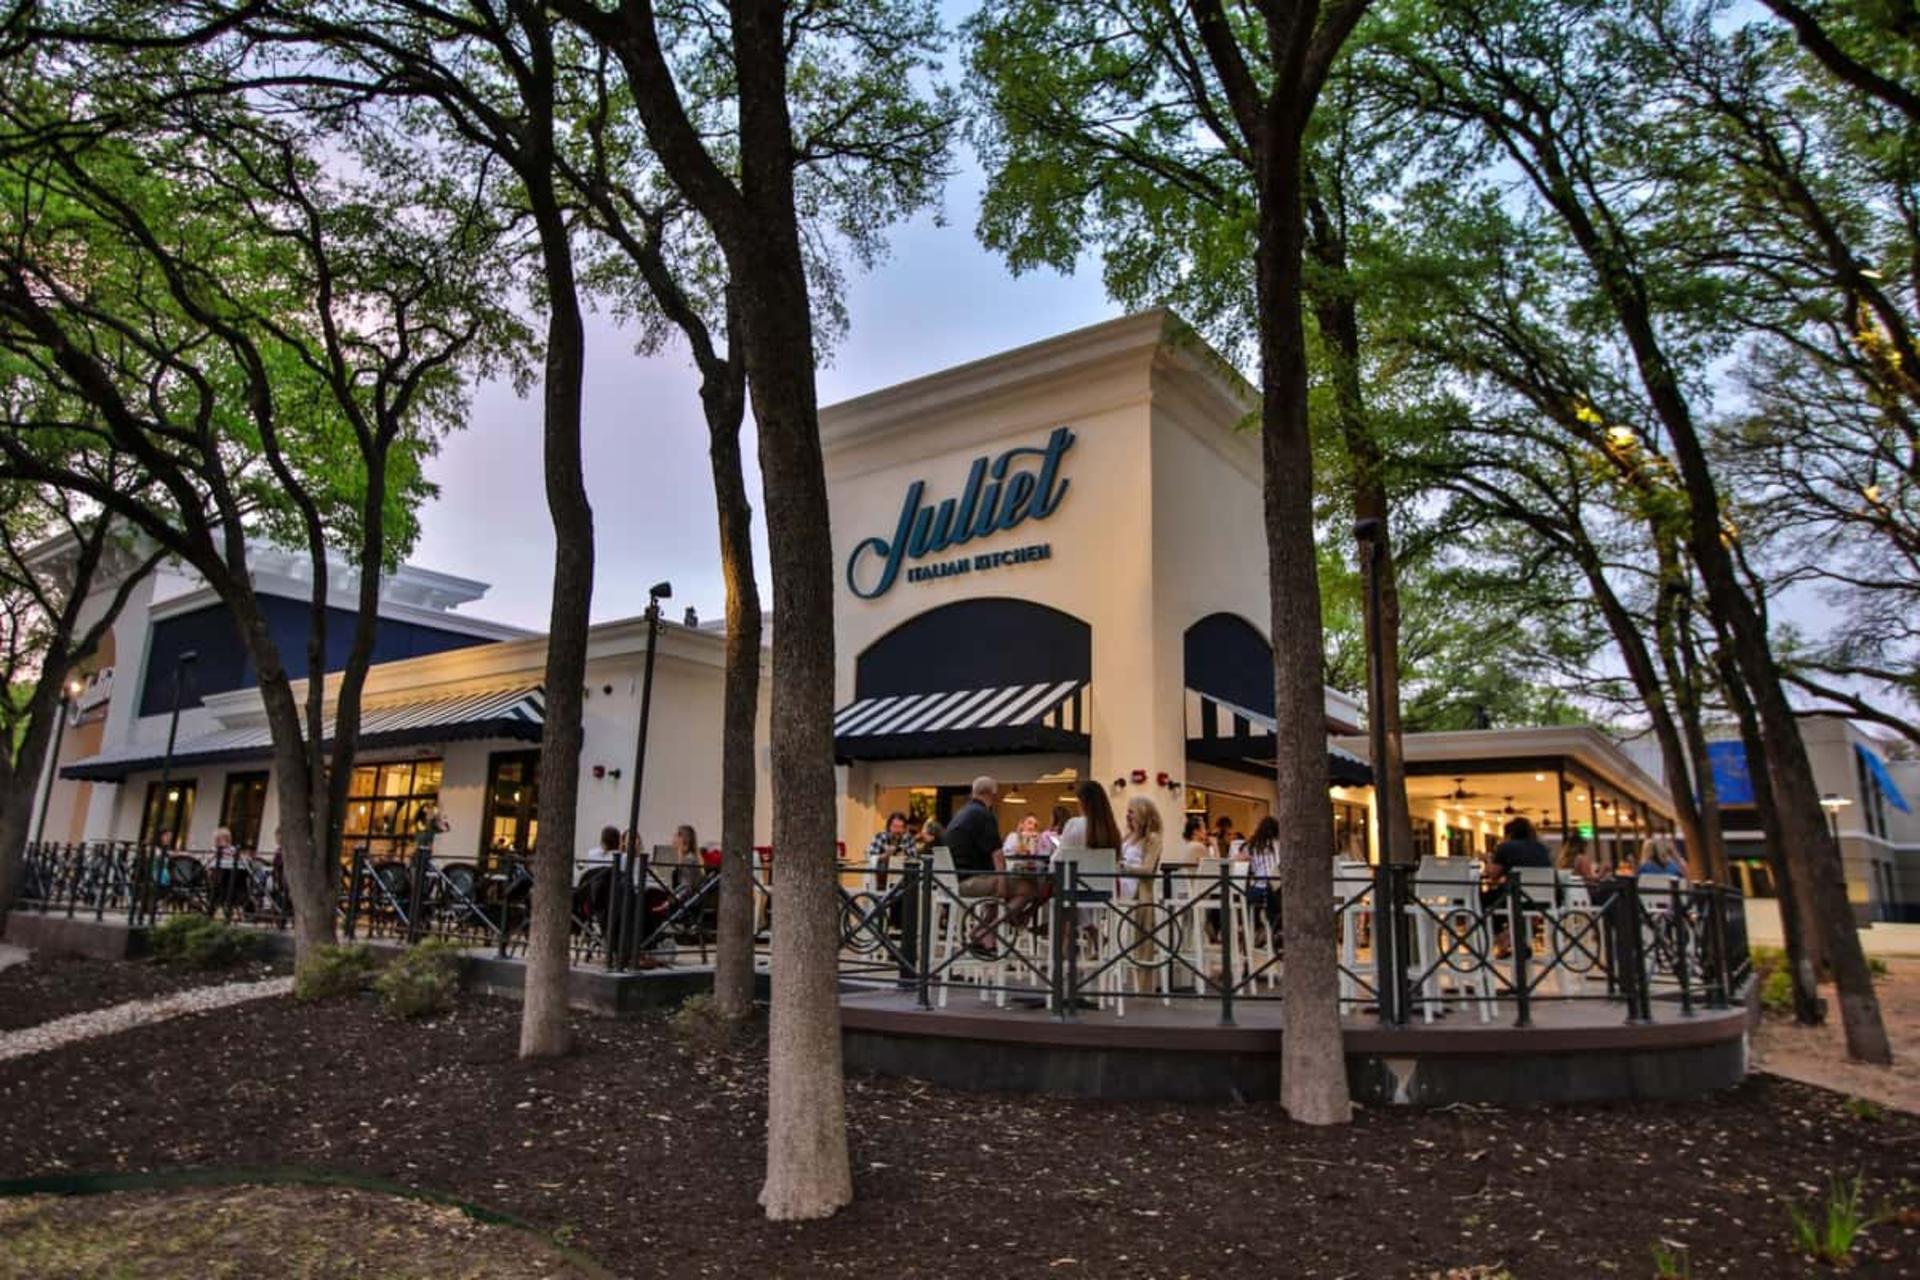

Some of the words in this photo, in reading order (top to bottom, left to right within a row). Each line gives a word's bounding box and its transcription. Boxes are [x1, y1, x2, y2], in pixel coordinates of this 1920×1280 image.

[847, 427, 1076, 600] Juliet
[908, 558, 971, 583] ITALIAN
[974, 543, 1052, 571] KITCHEN
